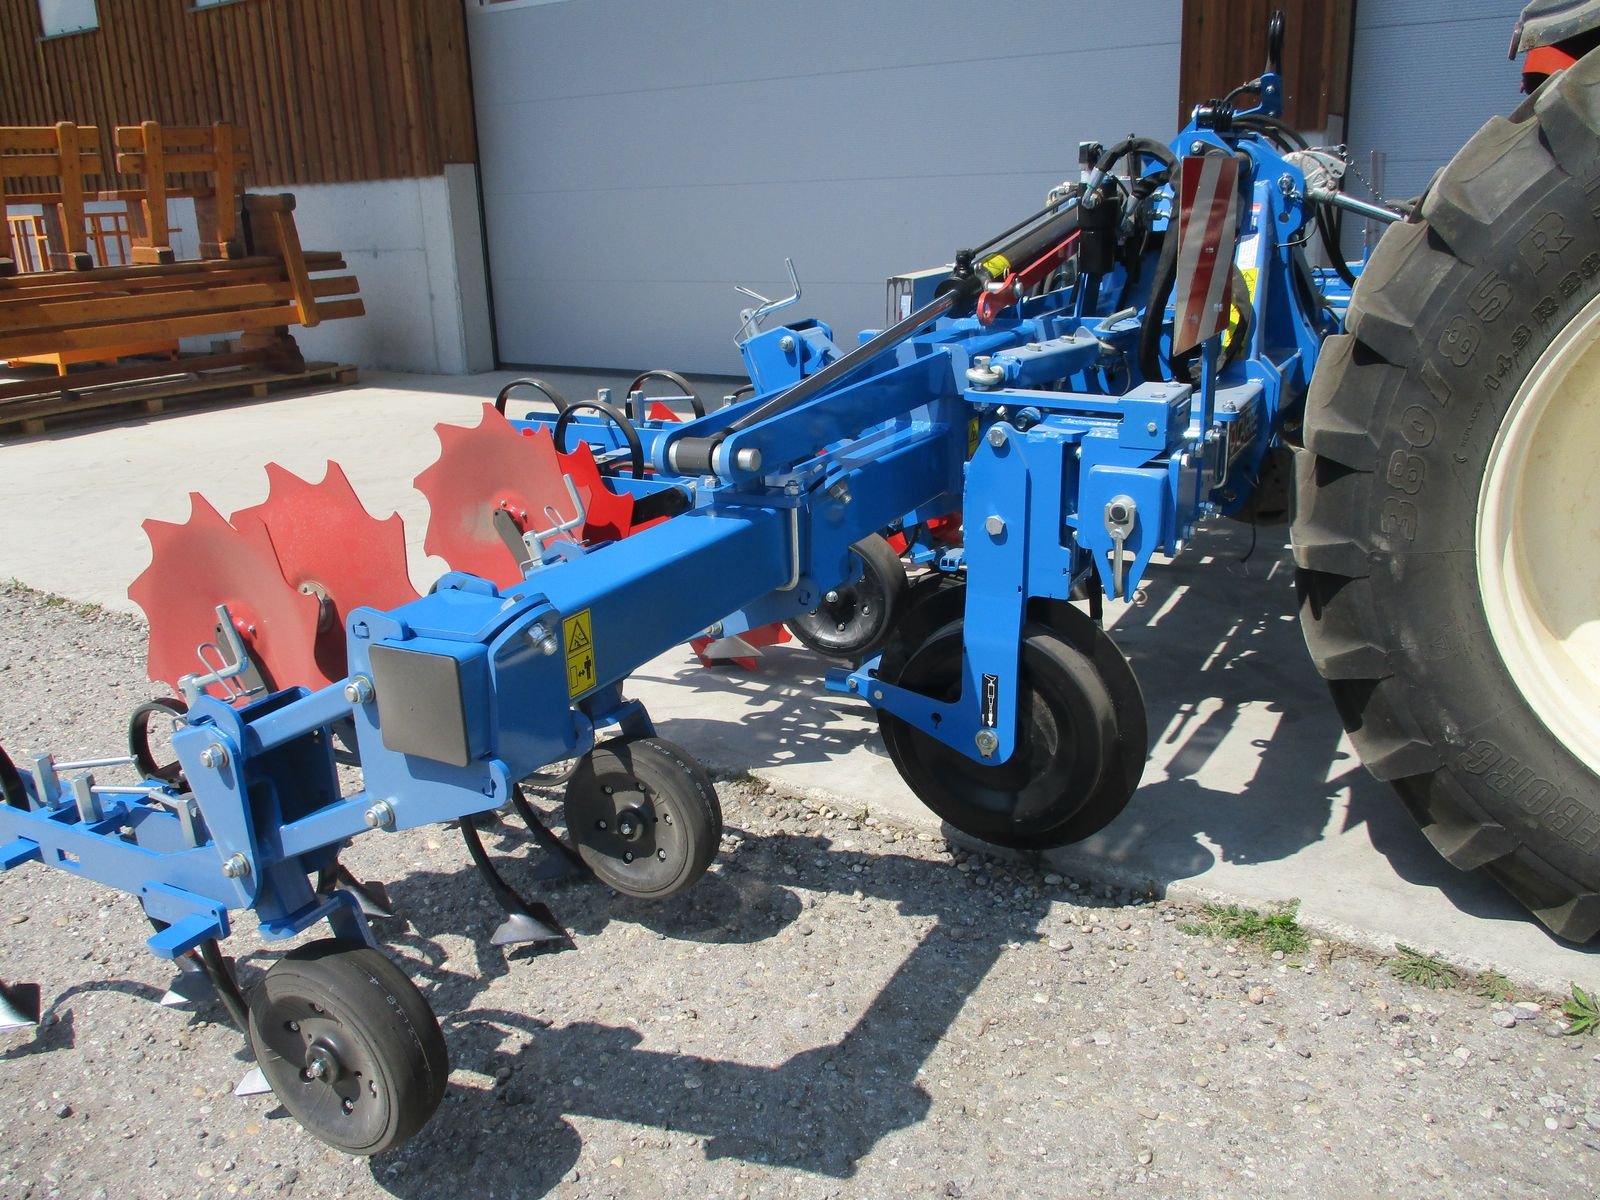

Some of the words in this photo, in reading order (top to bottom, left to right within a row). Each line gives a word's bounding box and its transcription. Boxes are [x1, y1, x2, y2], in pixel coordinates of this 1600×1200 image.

[1380, 271, 1513, 541] 380/85
[1516, 211, 1576, 276] R
[1484, 325, 1532, 392] 14.9
